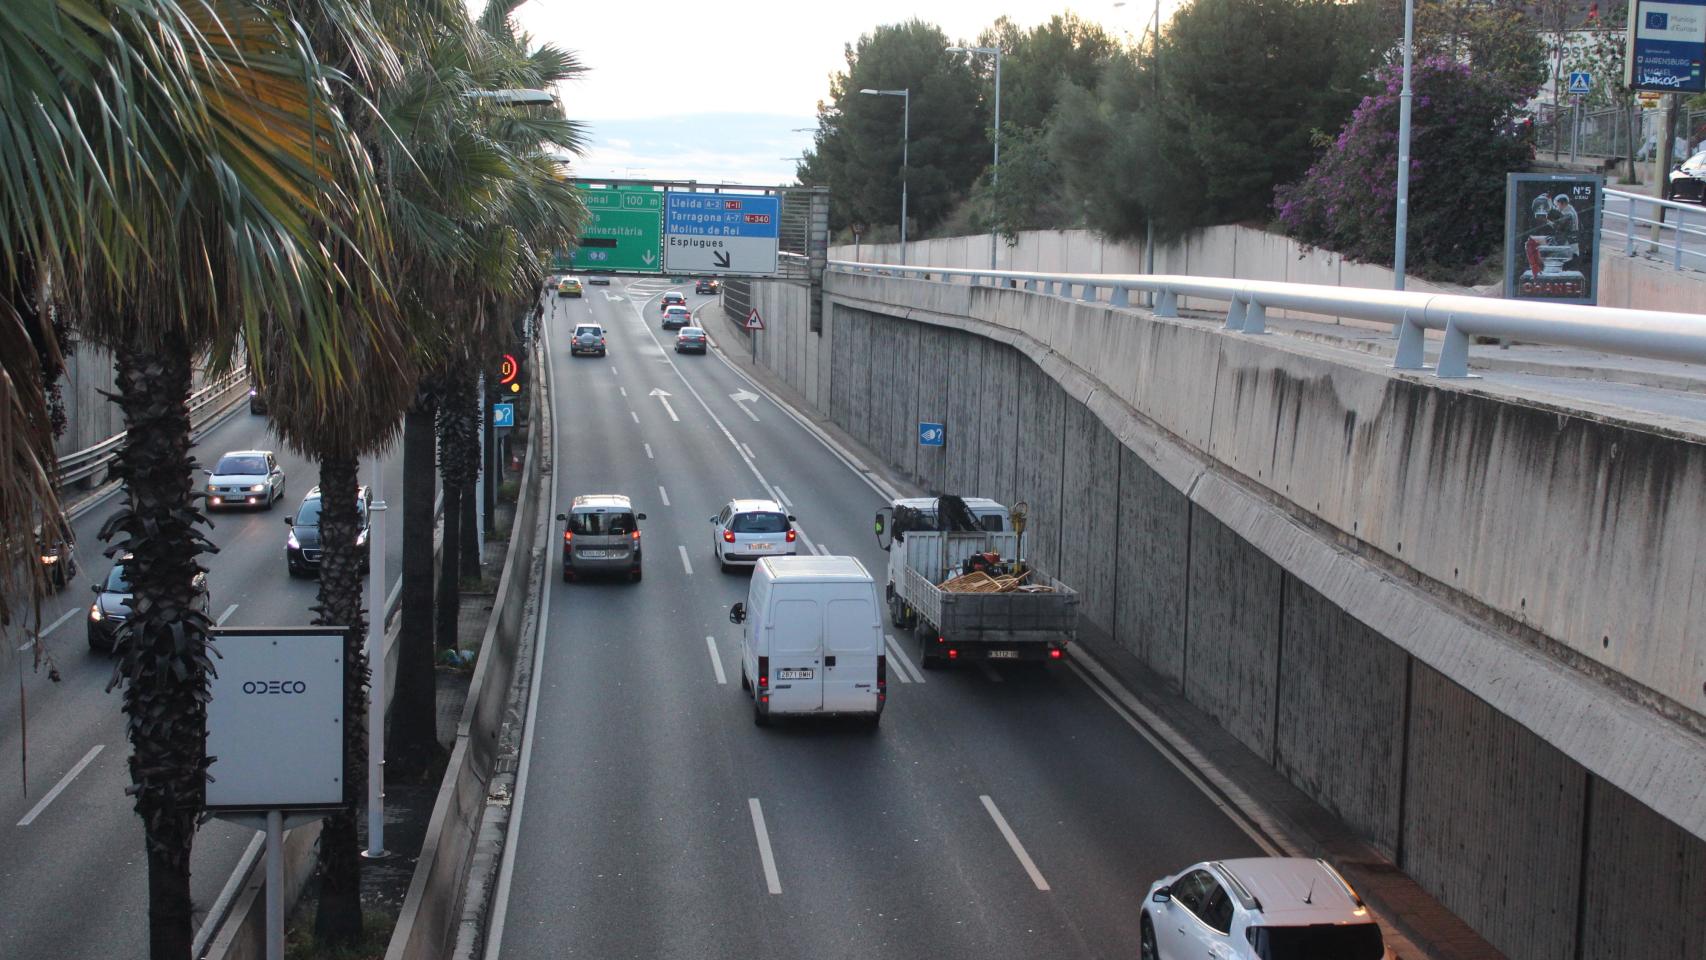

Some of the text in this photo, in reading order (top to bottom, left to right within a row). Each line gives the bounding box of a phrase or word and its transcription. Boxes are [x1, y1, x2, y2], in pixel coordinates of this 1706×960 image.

[1645, 56, 1690, 66] AHRENSBURG
[583, 195, 608, 206] gonal
[626, 196, 658, 206] 100 m
[671, 199, 702, 208] Lleida
[671, 211, 769, 223] Tarragona A-7 N-340
[670, 224, 740, 235] Molins de Rei
[670, 237, 724, 248] Esplugues
[242, 680, 307, 695] ODECO
